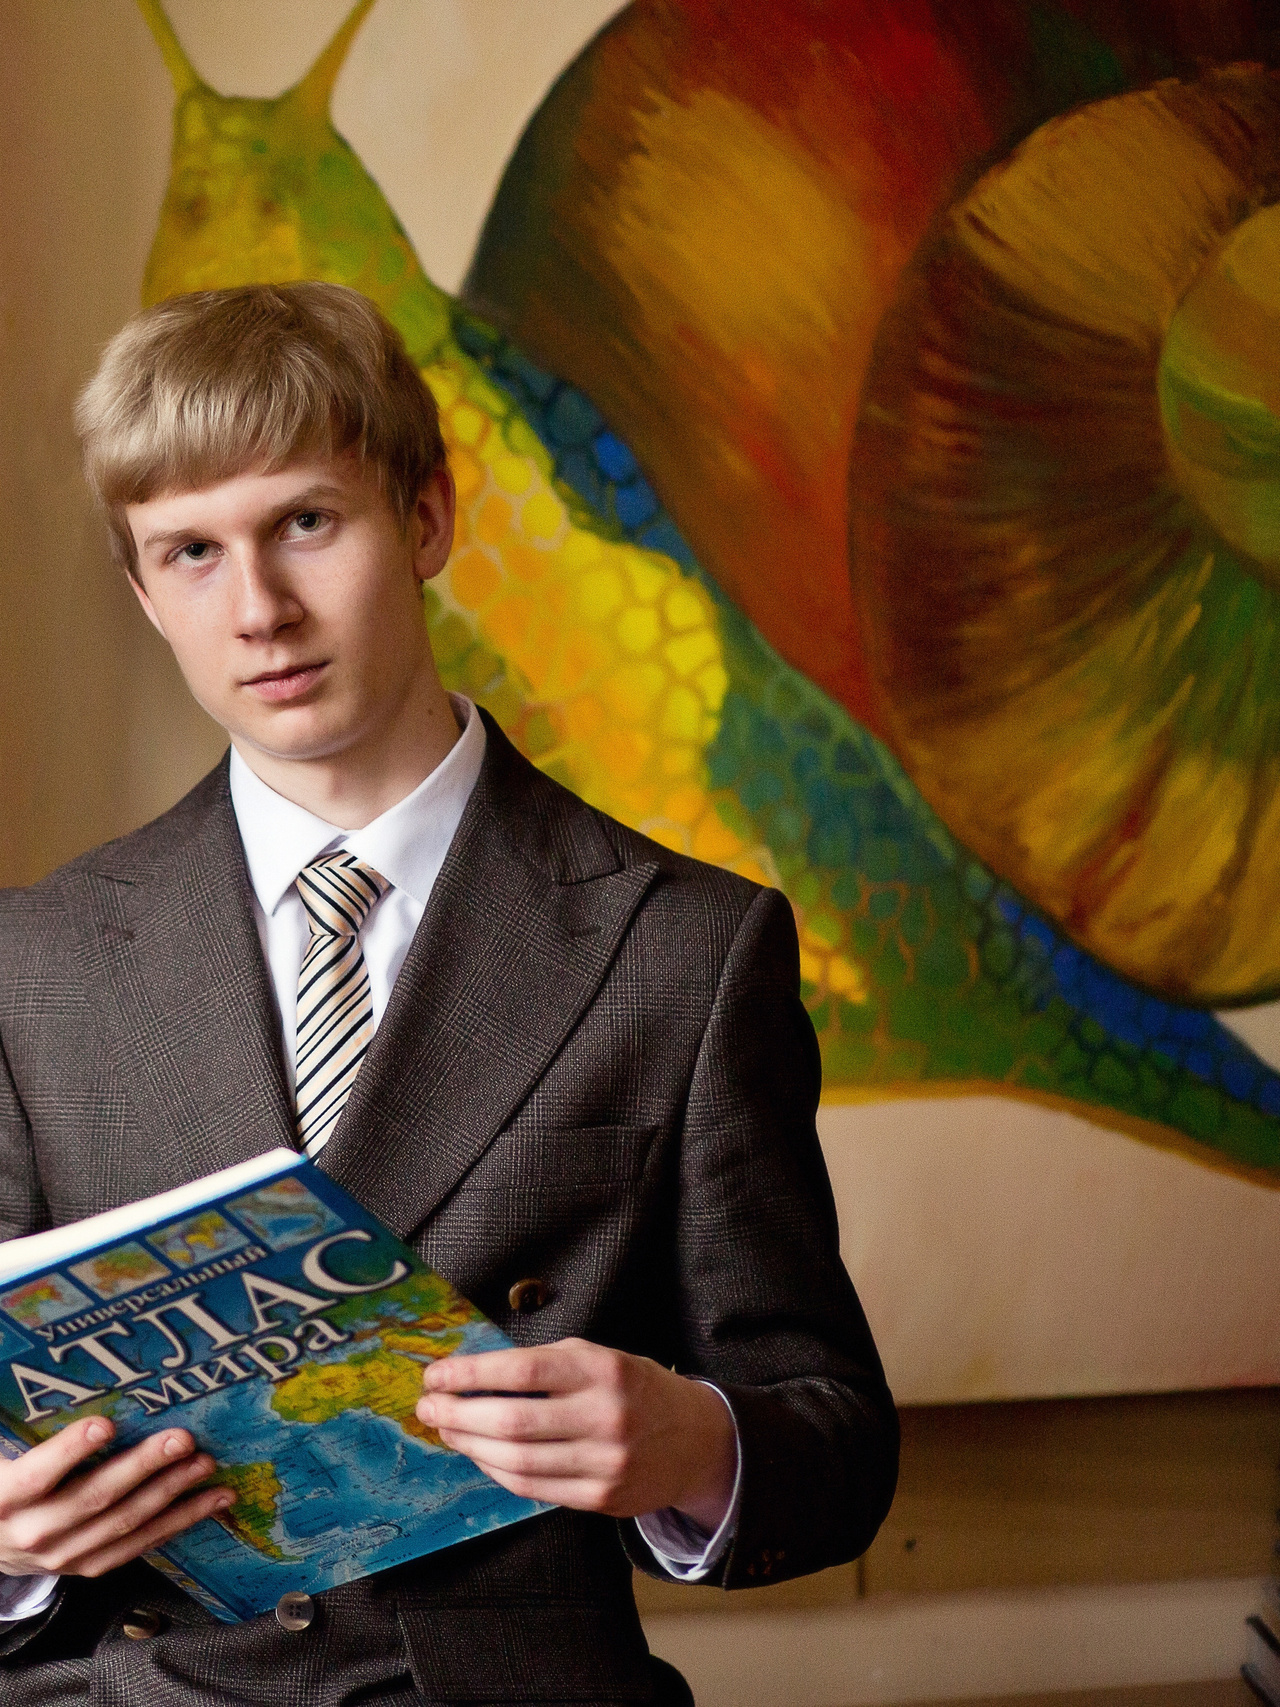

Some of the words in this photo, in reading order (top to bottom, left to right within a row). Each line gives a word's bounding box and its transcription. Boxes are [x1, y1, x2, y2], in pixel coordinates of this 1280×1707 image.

[11, 1230, 409, 1423] АТЛАС
[36, 1246, 267, 1342] Универсальный
[126, 1318, 350, 1416] мира
